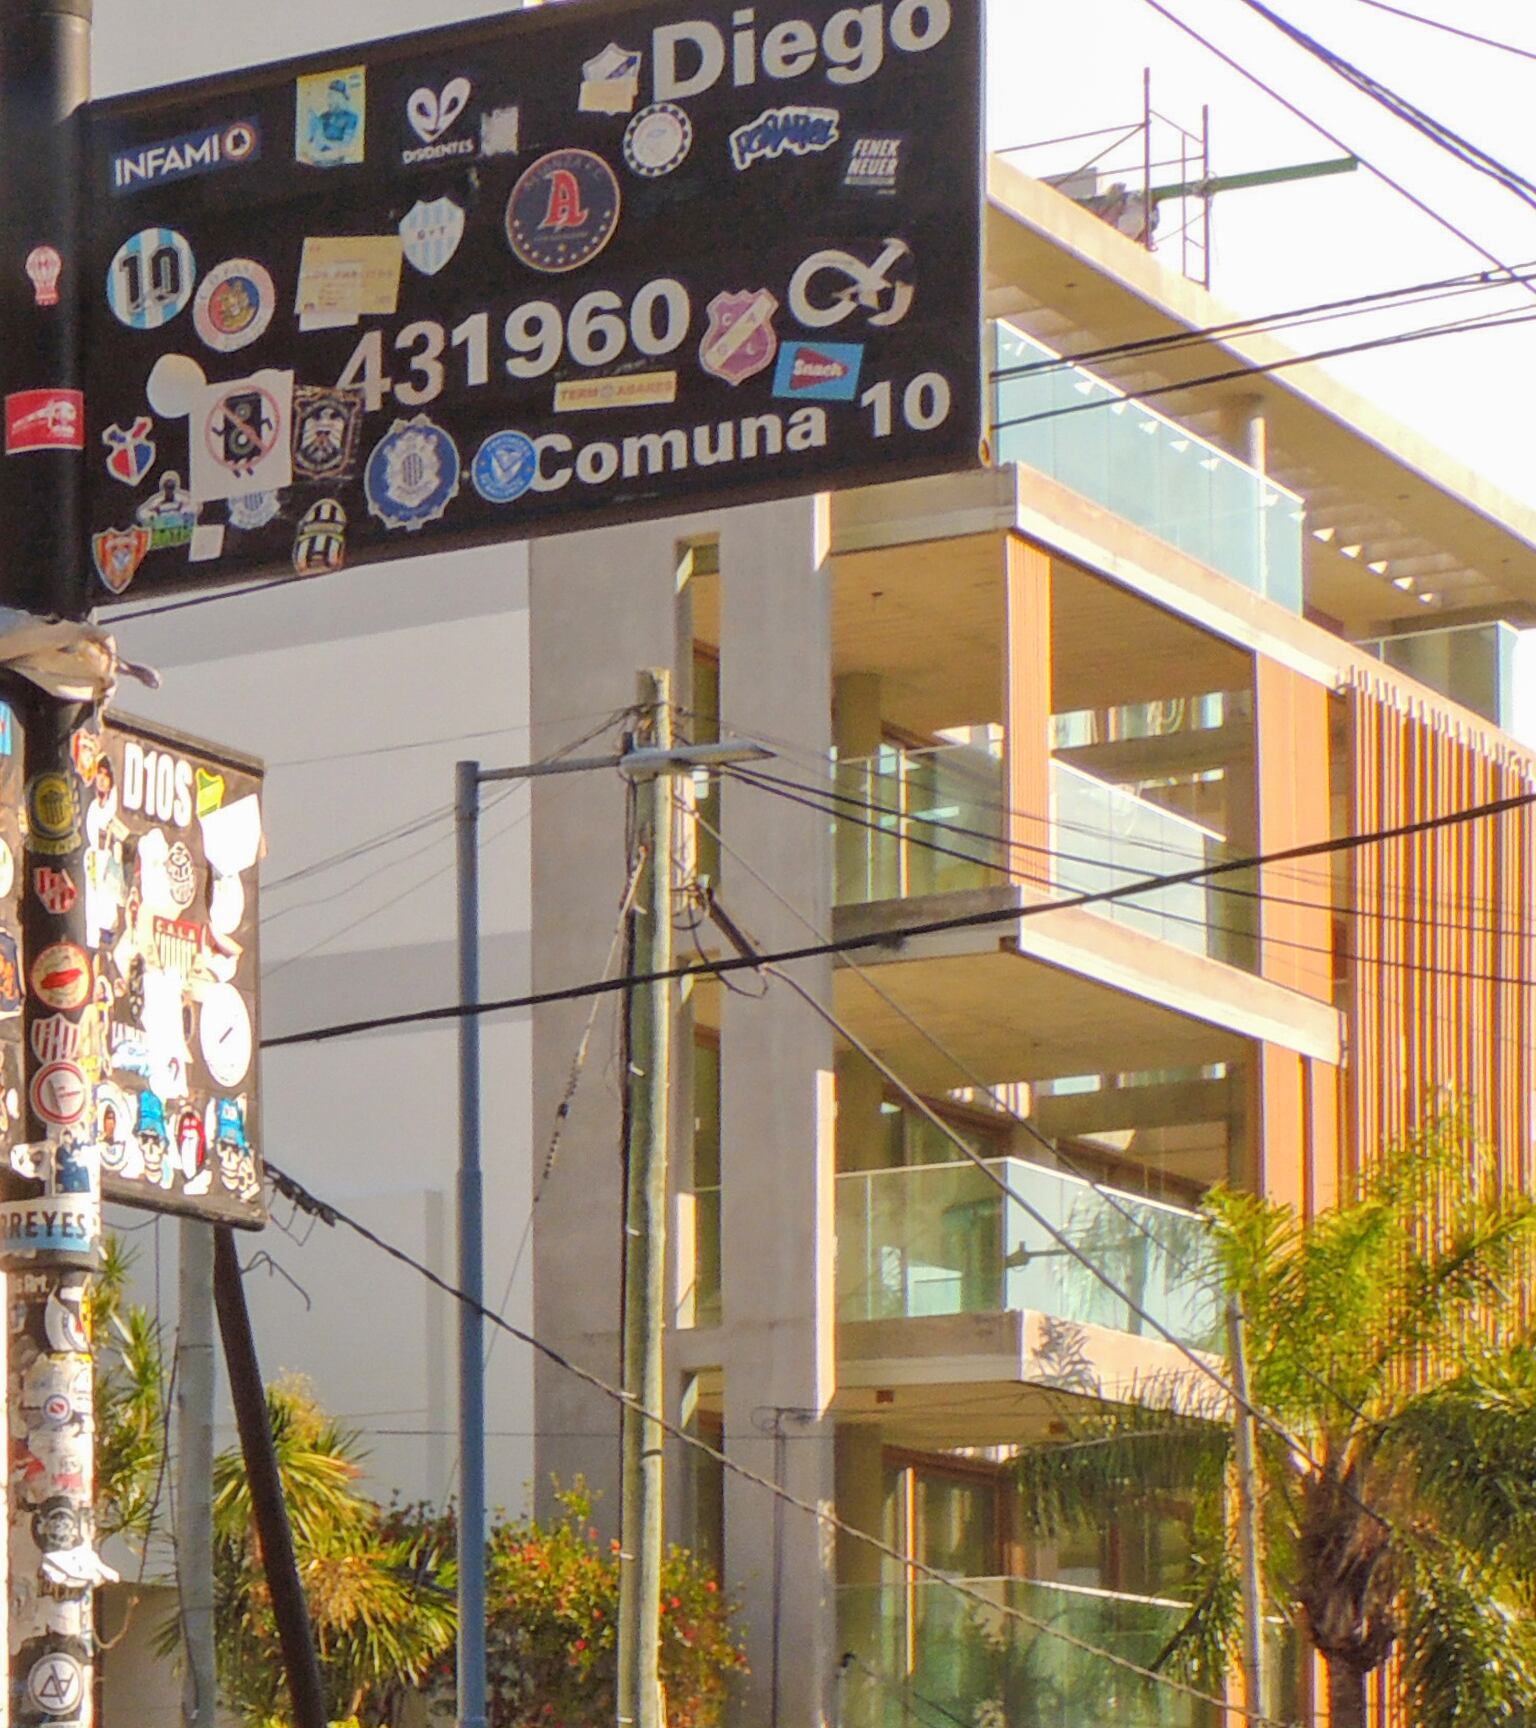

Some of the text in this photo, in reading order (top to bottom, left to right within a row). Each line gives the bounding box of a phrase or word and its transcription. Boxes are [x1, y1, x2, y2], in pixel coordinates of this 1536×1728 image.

[653, 0, 951, 101] Diego
[335, 278, 690, 412] 431960
[530, 407, 827, 492] Comuna
[861, 372, 950, 438] 10
